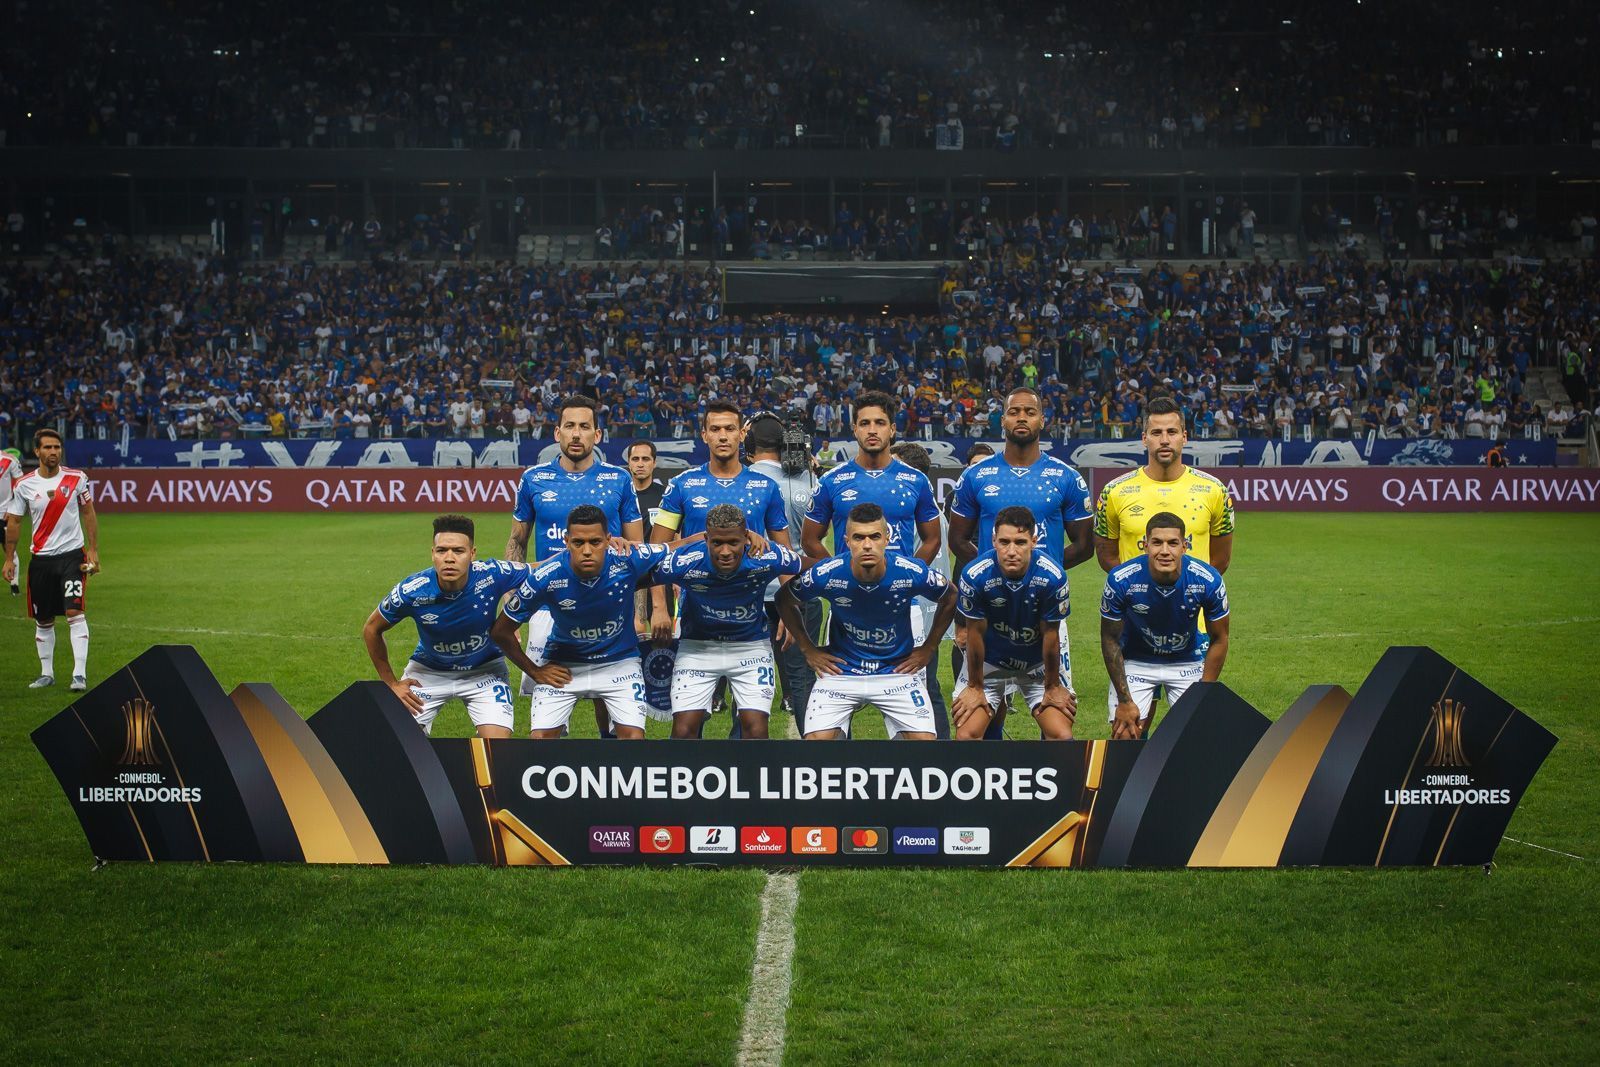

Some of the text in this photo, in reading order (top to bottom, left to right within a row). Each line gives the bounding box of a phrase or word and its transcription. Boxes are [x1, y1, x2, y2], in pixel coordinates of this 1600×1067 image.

[89, 480, 272, 503] TAR AIRWAYS
[306, 480, 521, 508] QATAR AIRWAY
[1228, 479, 1348, 501] AIRWAYS
[1382, 479, 1480, 506] QATAR
[64, 580, 82, 597] 23
[757, 667, 774, 687] 28
[1126, 675, 1146, 684] rgea
[1180, 666, 1203, 678] UninC
[492, 684, 513, 705] 20
[909, 689, 925, 707] 6
[521, 766, 1059, 801] CONMEBOL LIBERTADORES
[79, 787, 202, 803] LIBERTADORES
[1384, 789, 1511, 805] LIBERTADORES
[593, 831, 630, 842] QATAR
[903, 835, 936, 846] Rexona
[744, 843, 782, 851] Santander
